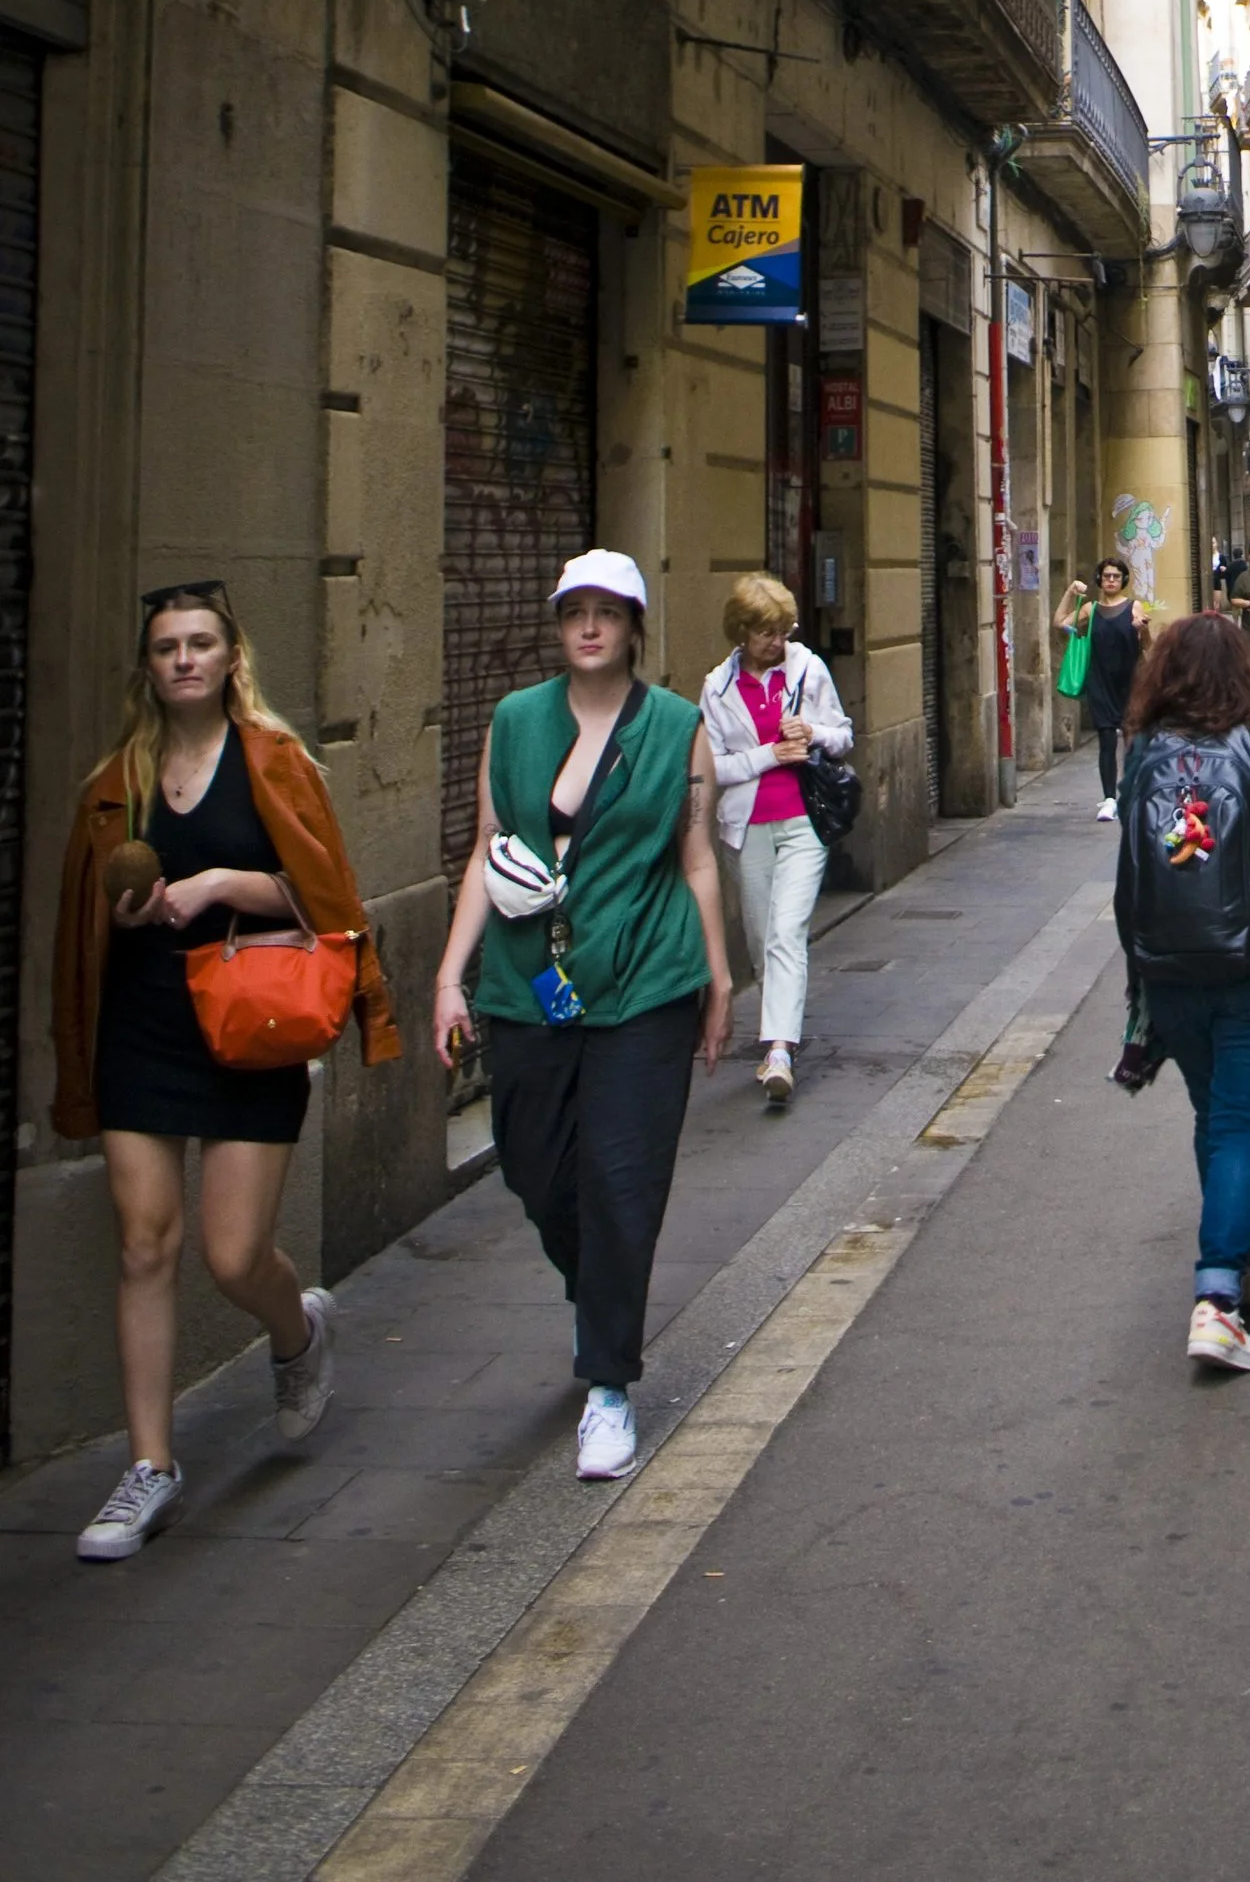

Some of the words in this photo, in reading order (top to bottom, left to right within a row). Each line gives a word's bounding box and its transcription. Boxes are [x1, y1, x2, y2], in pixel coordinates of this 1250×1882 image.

[710, 193, 780, 219] ATM
[707, 225, 780, 249] Cajero
[823, 381, 860, 393] HOSTAL
[827, 395, 857, 411] ALBI
